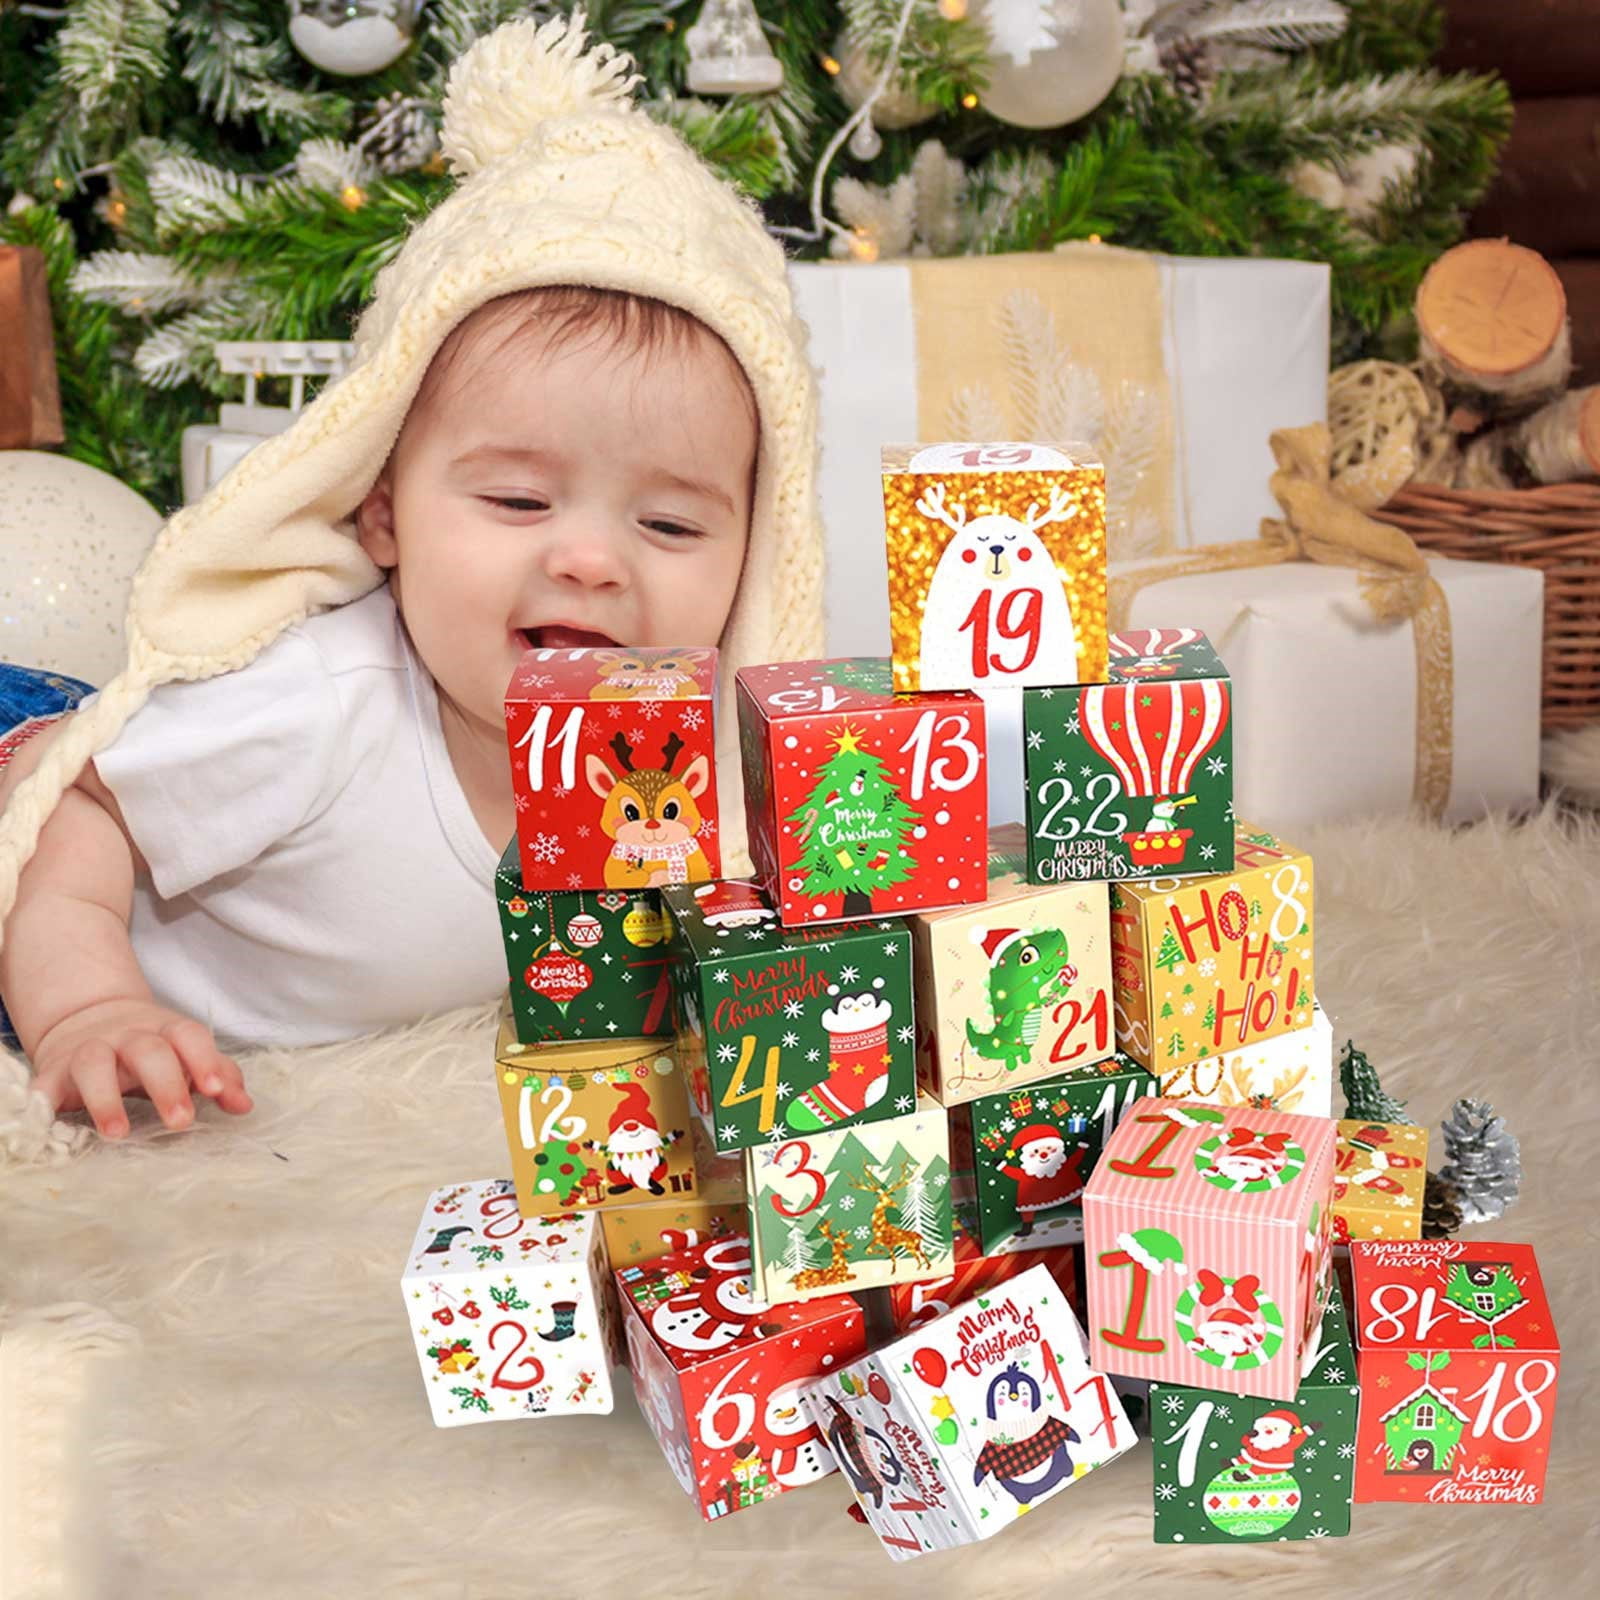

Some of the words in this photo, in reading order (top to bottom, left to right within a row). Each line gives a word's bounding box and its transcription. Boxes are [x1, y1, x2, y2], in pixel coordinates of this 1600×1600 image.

[949, 448, 1033, 467] 19
[957, 587, 1043, 679] 19
[513, 705, 585, 792] 11
[899, 710, 980, 801] 13
[818, 822, 893, 847] Christmas
[833, 808, 878, 827] Merry
[1034, 773, 1129, 841] 22
[1036, 854, 1129, 882] CHRISTMAS
[1269, 864, 1307, 942] 8
[1169, 888, 1249, 965] HO
[627, 957, 681, 1034] 7
[710, 969, 832, 1035] Christmas
[730, 955, 807, 997] Merry
[1049, 988, 1109, 1064] 21
[518, 1086, 588, 1150] 12
[719, 1034, 781, 1134] 4
[769, 1140, 827, 1218] 3
[908, 1276, 955, 1329] 5
[956, 1297, 1021, 1346] Merry
[487, 1320, 545, 1391] 2
[950, 1306, 1042, 1378] Christmas
[699, 1358, 756, 1450] 6
[1040, 1338, 1118, 1450] 17
[1462, 1358, 1557, 1443] 18
[1163, 1400, 1215, 1488] 1
[1456, 1463, 1526, 1488] Merry
[1425, 1478, 1539, 1504] Christmas
